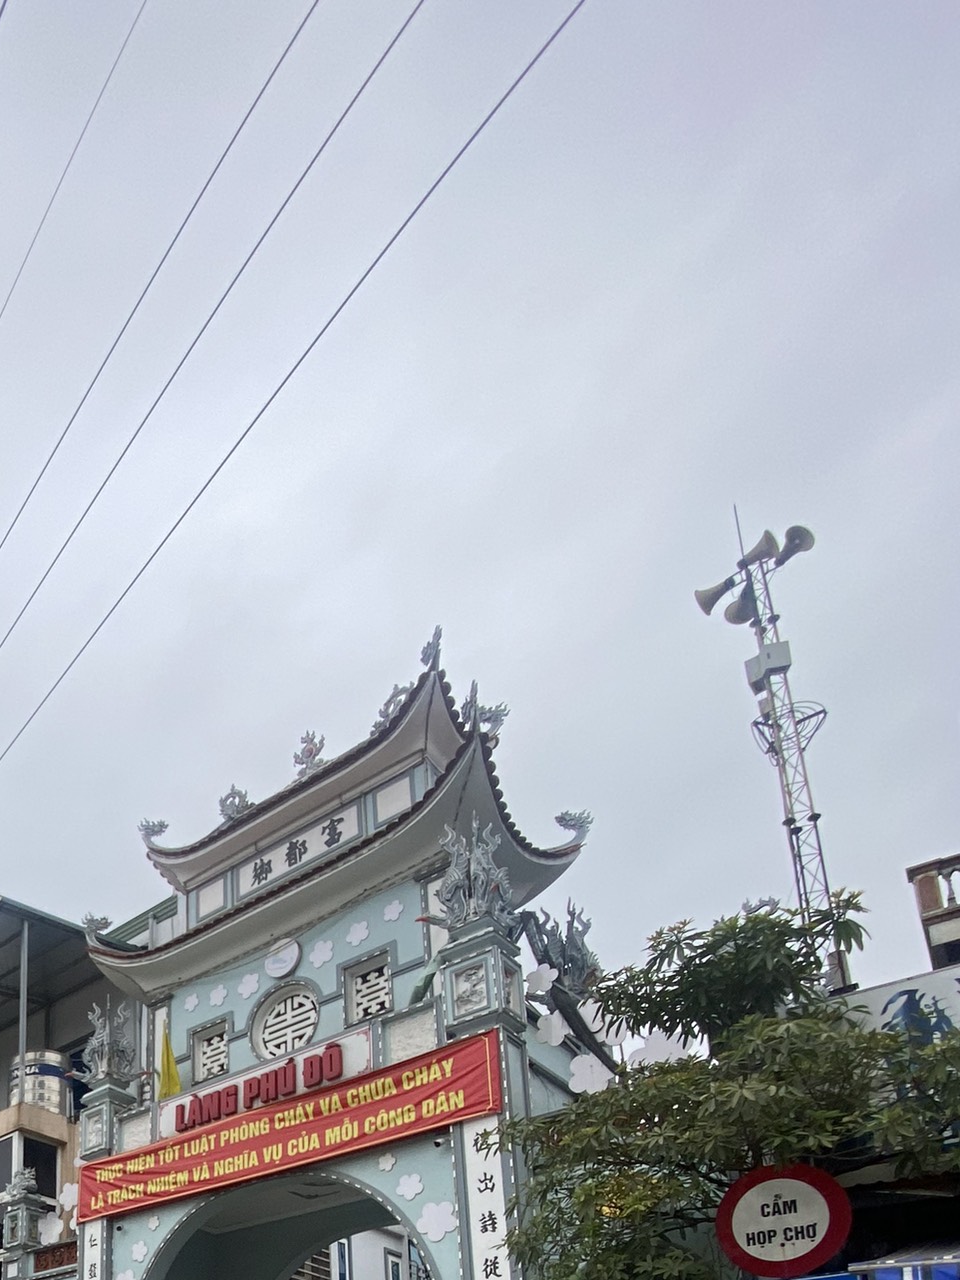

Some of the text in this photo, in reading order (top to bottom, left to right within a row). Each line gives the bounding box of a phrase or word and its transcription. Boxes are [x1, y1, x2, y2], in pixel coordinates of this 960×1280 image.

[95, 1164, 124, 1184] THỰC
[126, 1155, 155, 1175] HIỆN
[158, 1142, 180, 1166] TỐT
[183, 1134, 216, 1157] LUẬT
[220, 1119, 270, 1147] PHÒNG
[274, 1101, 315, 1130] CHÁY
[319, 1094, 344, 1115] VÀ
[402, 1057, 454, 1090] CHÁY
[175, 1042, 344, 1133] LÀNG PHÚ ĐÔ
[90, 1090, 465, 1210] LÀ TRÁCH NHIỆM VÀ NGHĨA VỤ CỦA MỖI CÔNG DÂN
[746, 1222, 818, 1248] HỌP CHỢ
